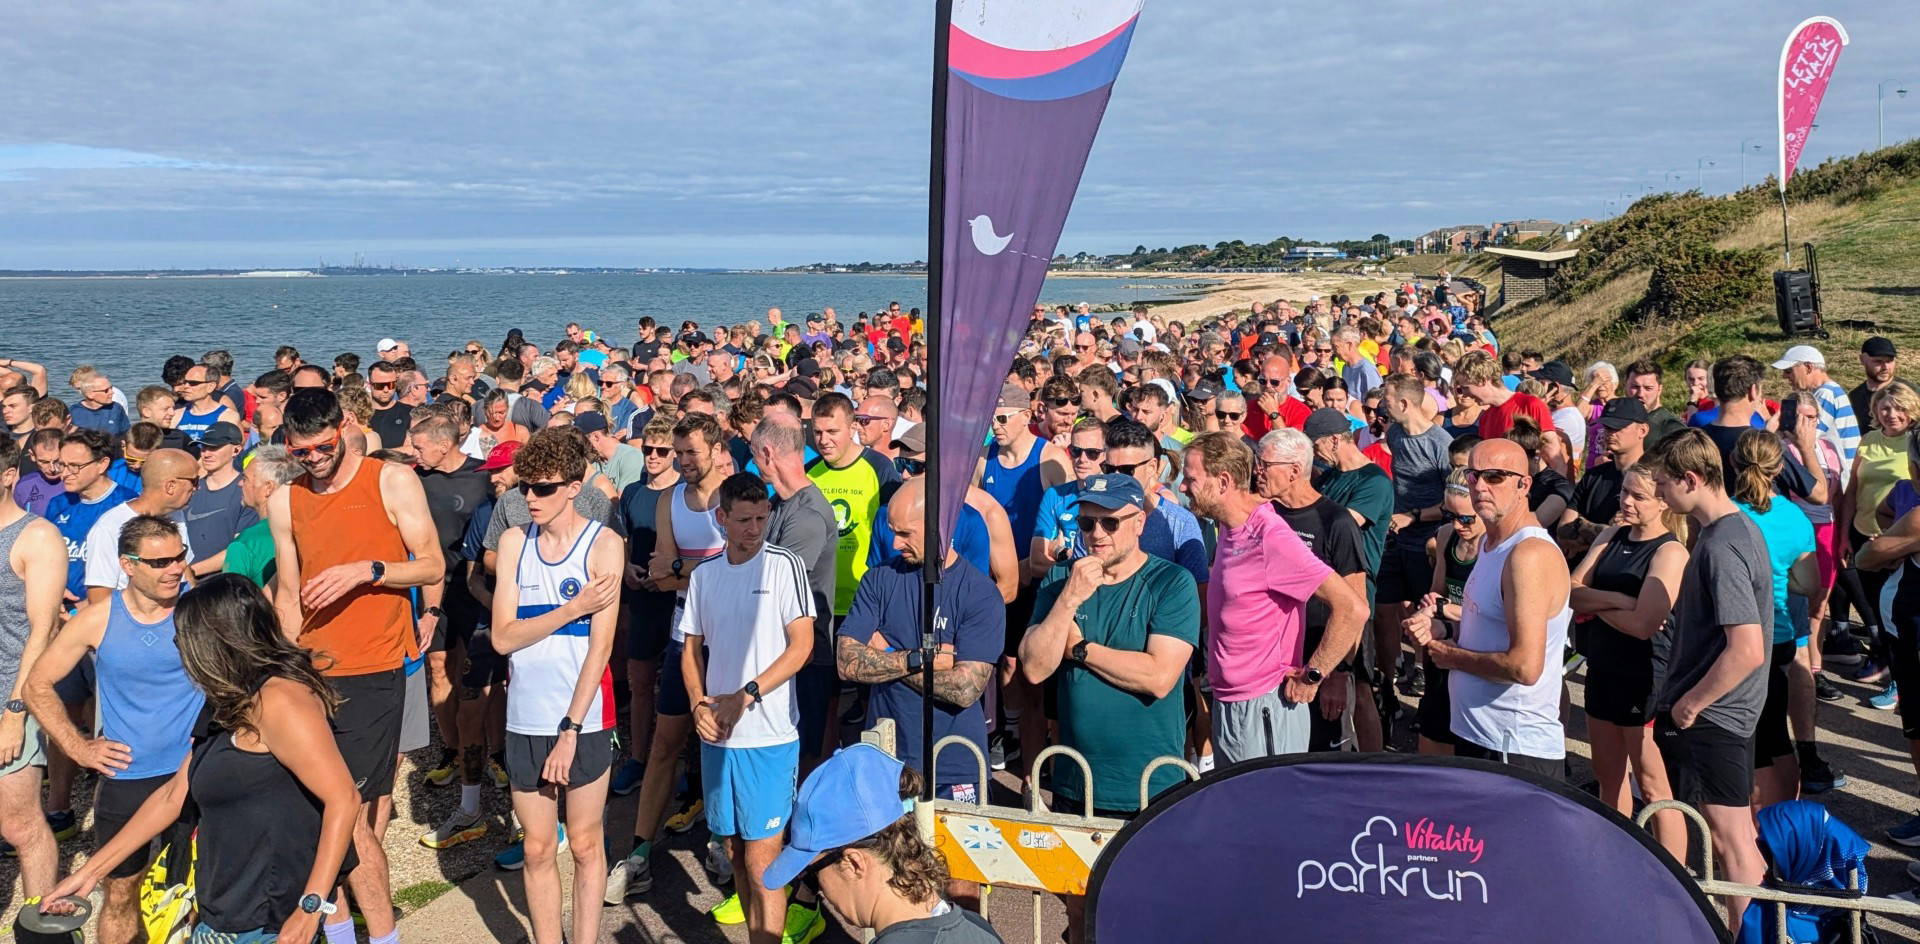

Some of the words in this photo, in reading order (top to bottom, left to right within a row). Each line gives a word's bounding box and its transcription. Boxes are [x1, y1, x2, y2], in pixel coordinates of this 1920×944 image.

[1786, 40, 1818, 88] LET'S
[1801, 38, 1835, 84] WALK
[1297, 816, 1488, 904] parkrun
[1405, 816, 1484, 864] Vitality
[1407, 854, 1438, 863] partners
